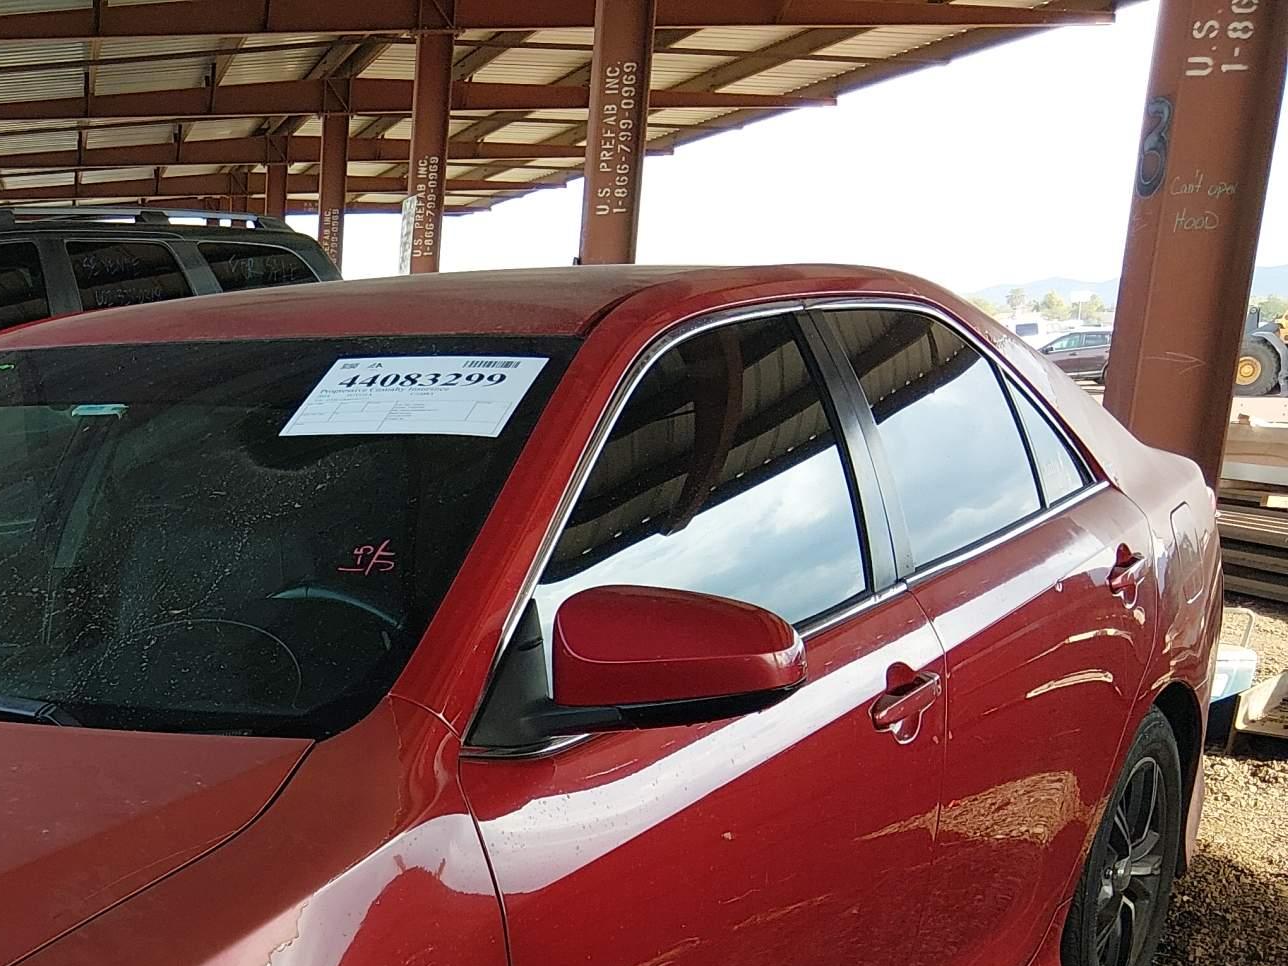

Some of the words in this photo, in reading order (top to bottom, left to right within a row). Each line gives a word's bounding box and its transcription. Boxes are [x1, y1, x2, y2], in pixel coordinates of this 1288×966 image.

[605, 61, 621, 94] INC.
[599, 103, 617, 172] PREFAB
[417, 155, 429, 178] INC.
[415, 184, 426, 229] PREFAB
[338, 372, 508, 388] 44083299
